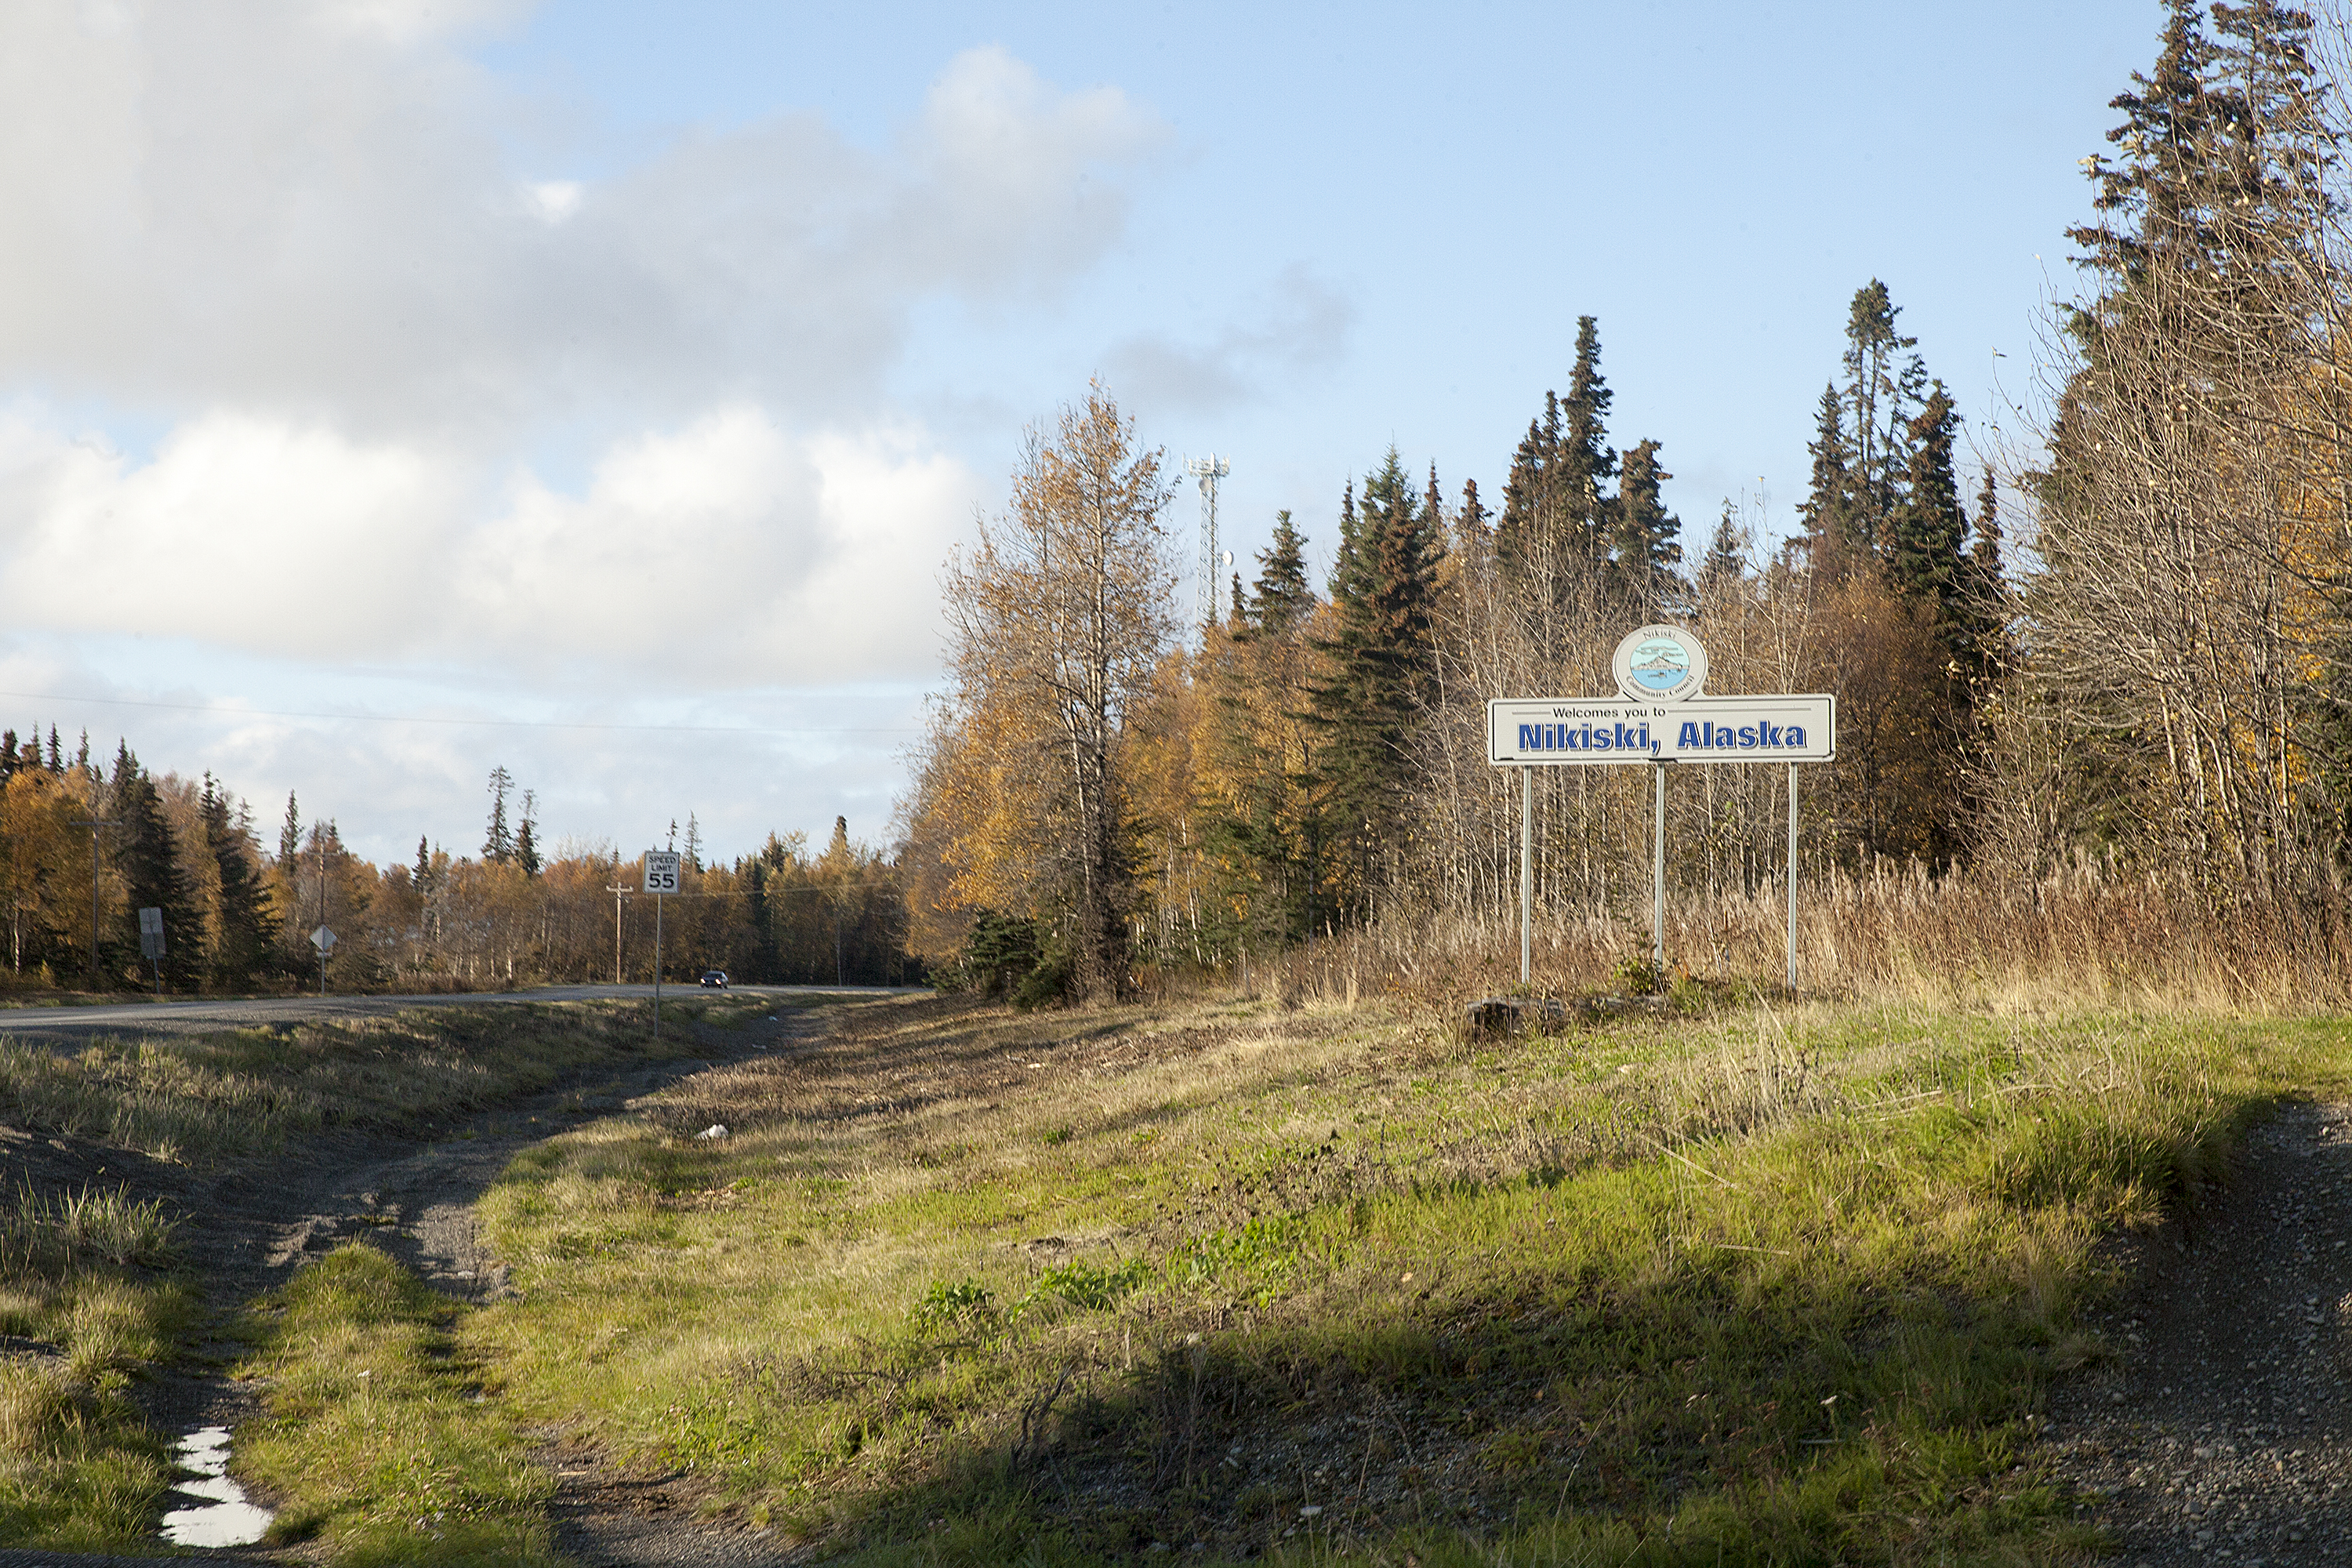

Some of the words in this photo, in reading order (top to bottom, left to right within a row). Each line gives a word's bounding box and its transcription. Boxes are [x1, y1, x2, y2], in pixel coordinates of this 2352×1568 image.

[1642, 628, 1678, 640] Nikiski
[1626, 675, 1666, 699] Community
[1668, 674, 1695, 695] Council
[1553, 706, 1619, 718] Welcomes
[1624, 708, 1647, 719] you
[1653, 707, 1666, 717] to
[1519, 721, 1661, 756] Nikiski,
[1676, 720, 1807, 750] Alaska
[648, 855, 677, 864] SPEED
[649, 873, 674, 888] 55
